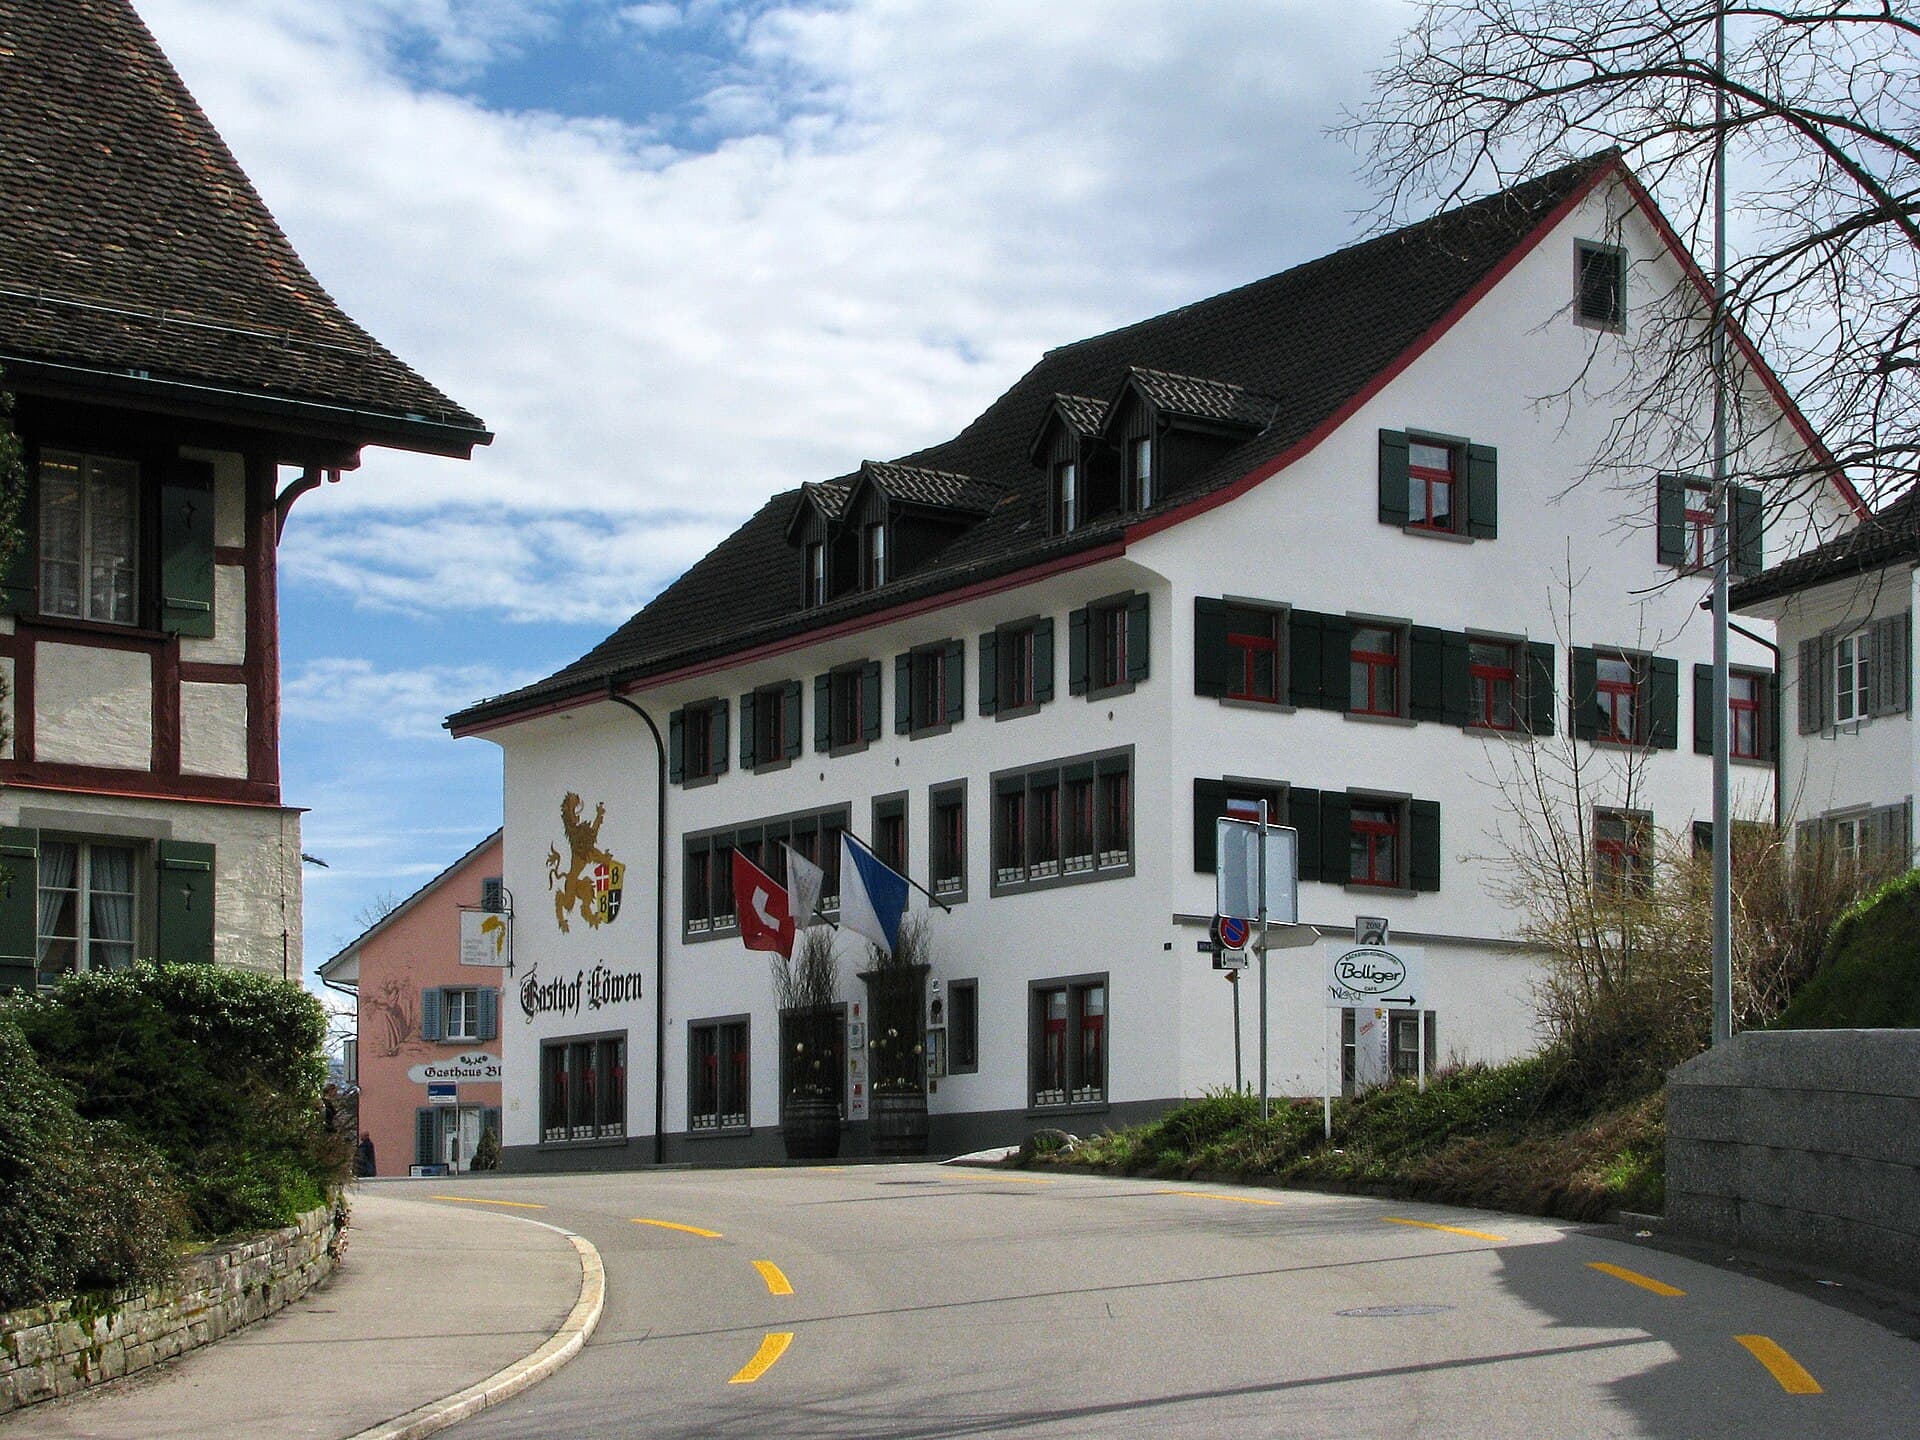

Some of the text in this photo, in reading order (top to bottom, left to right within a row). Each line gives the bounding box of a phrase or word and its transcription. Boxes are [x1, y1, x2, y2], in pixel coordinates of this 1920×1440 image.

[1366, 921, 1381, 930] ZONE
[1340, 962, 1401, 984] Bolliger
[520, 959, 642, 1024] Gasthof Löwen
[425, 1066, 502, 1078] Gasthaus Bl
